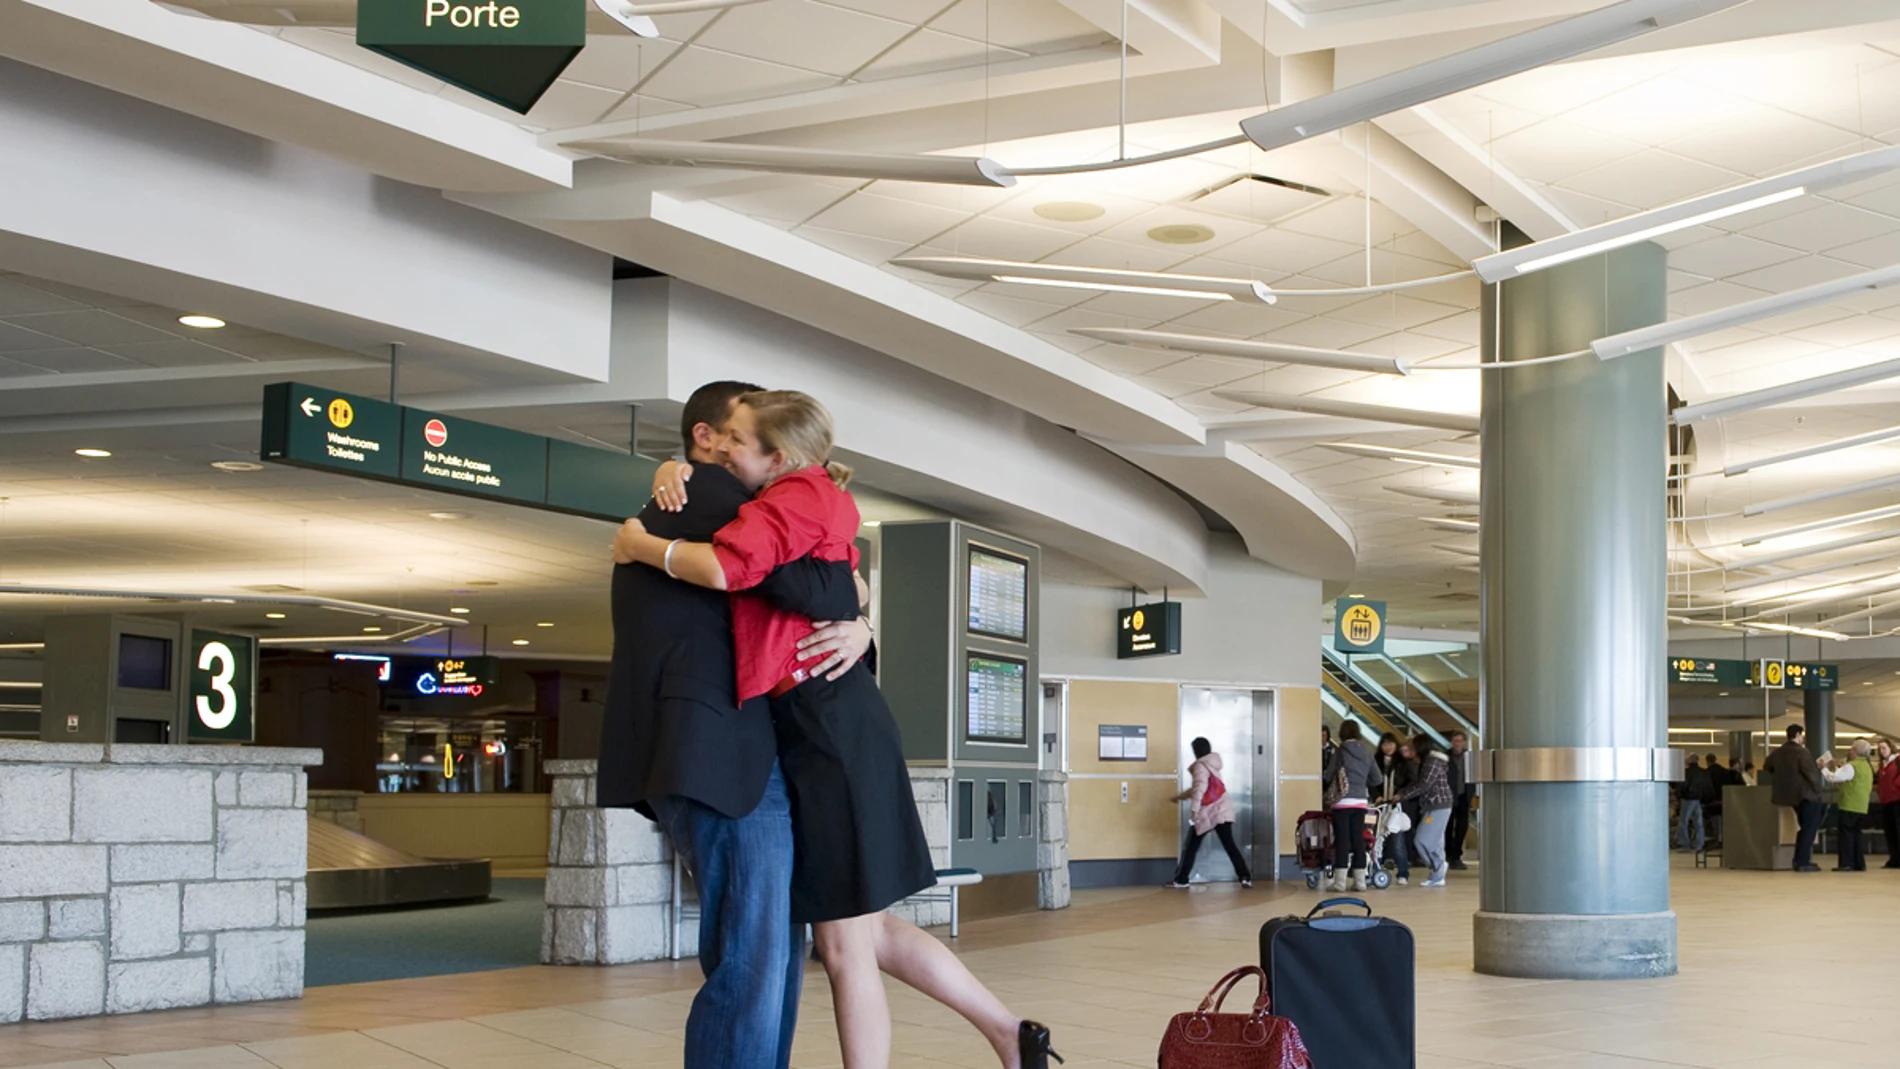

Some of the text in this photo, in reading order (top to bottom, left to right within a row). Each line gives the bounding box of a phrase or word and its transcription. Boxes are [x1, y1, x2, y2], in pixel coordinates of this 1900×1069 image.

[425, 0, 520, 27] Porte
[326, 432, 379, 451] Washrooms
[326, 445, 364, 461] Toilettes
[423, 450, 491, 473] No Public Access
[422, 463, 450, 477] Aucun
[476, 474, 501, 487] public
[196, 641, 238, 730] 3
